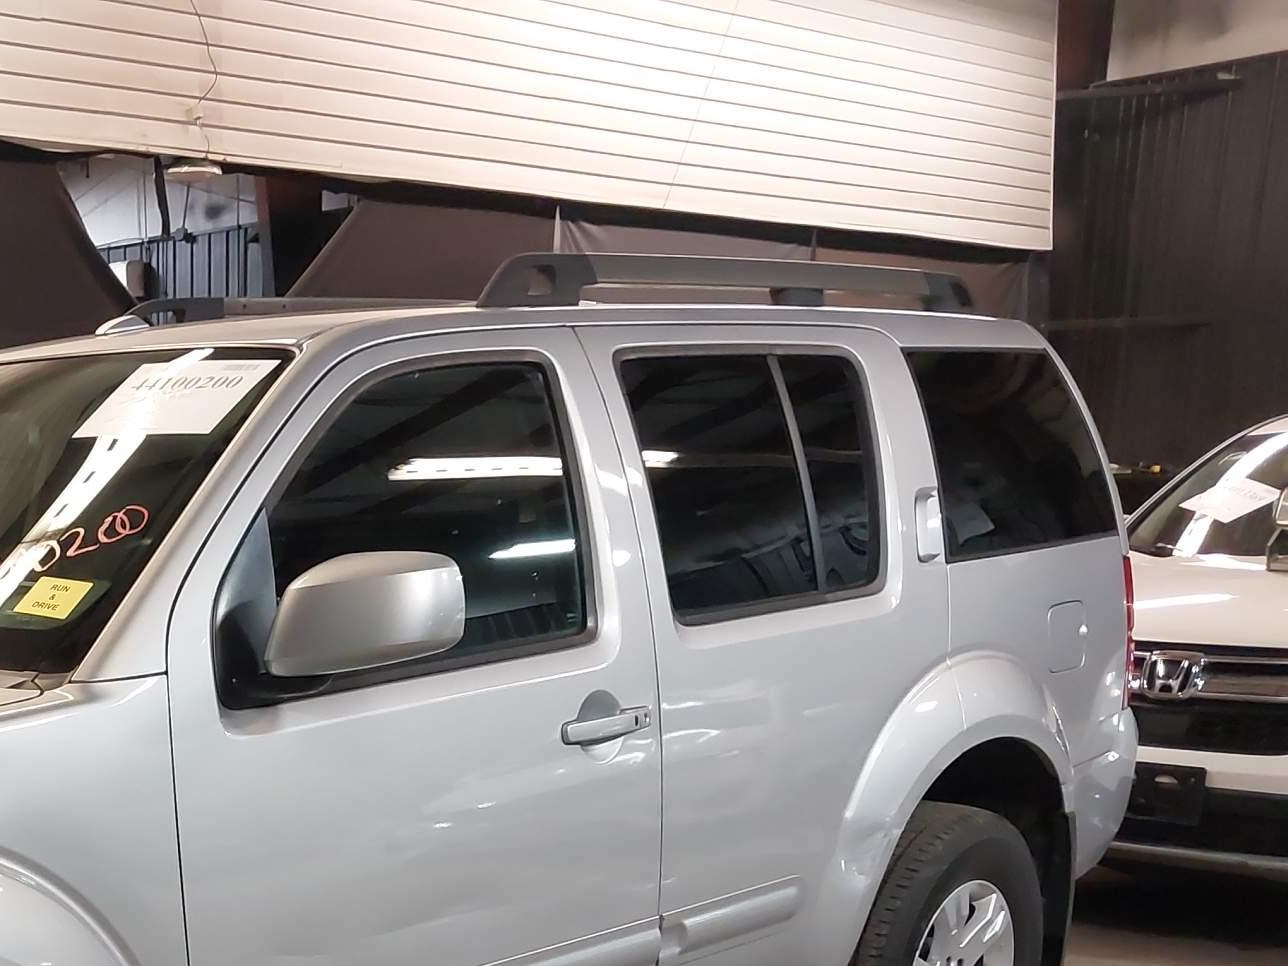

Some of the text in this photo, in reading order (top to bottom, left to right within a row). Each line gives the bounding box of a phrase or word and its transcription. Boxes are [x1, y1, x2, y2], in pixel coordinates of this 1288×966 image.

[130, 375, 244, 391] 44100200
[49, 583, 71, 593] RUN
[48, 593, 57, 601] &
[31, 600, 60, 611] DRIVE
